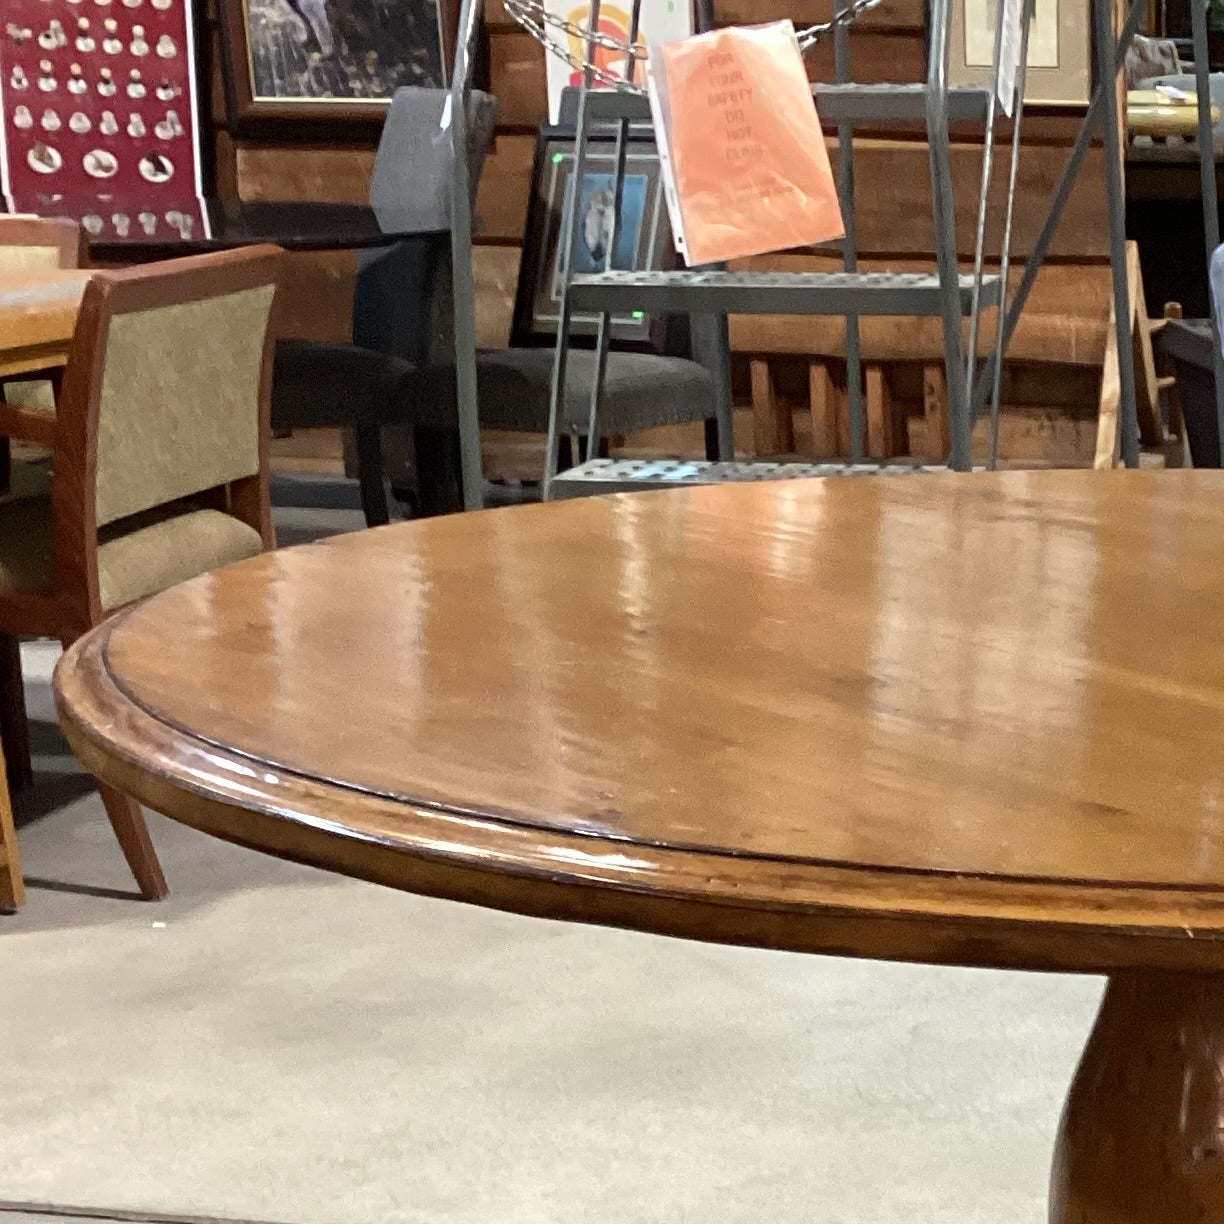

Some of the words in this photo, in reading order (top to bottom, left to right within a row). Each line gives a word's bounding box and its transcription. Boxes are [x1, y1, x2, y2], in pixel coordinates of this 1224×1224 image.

[707, 52, 734, 69] FOR
[710, 70, 745, 87] YOUR
[707, 88, 753, 107] SAFETY
[726, 109, 744, 124] DO
[726, 126, 752, 142] NOT
